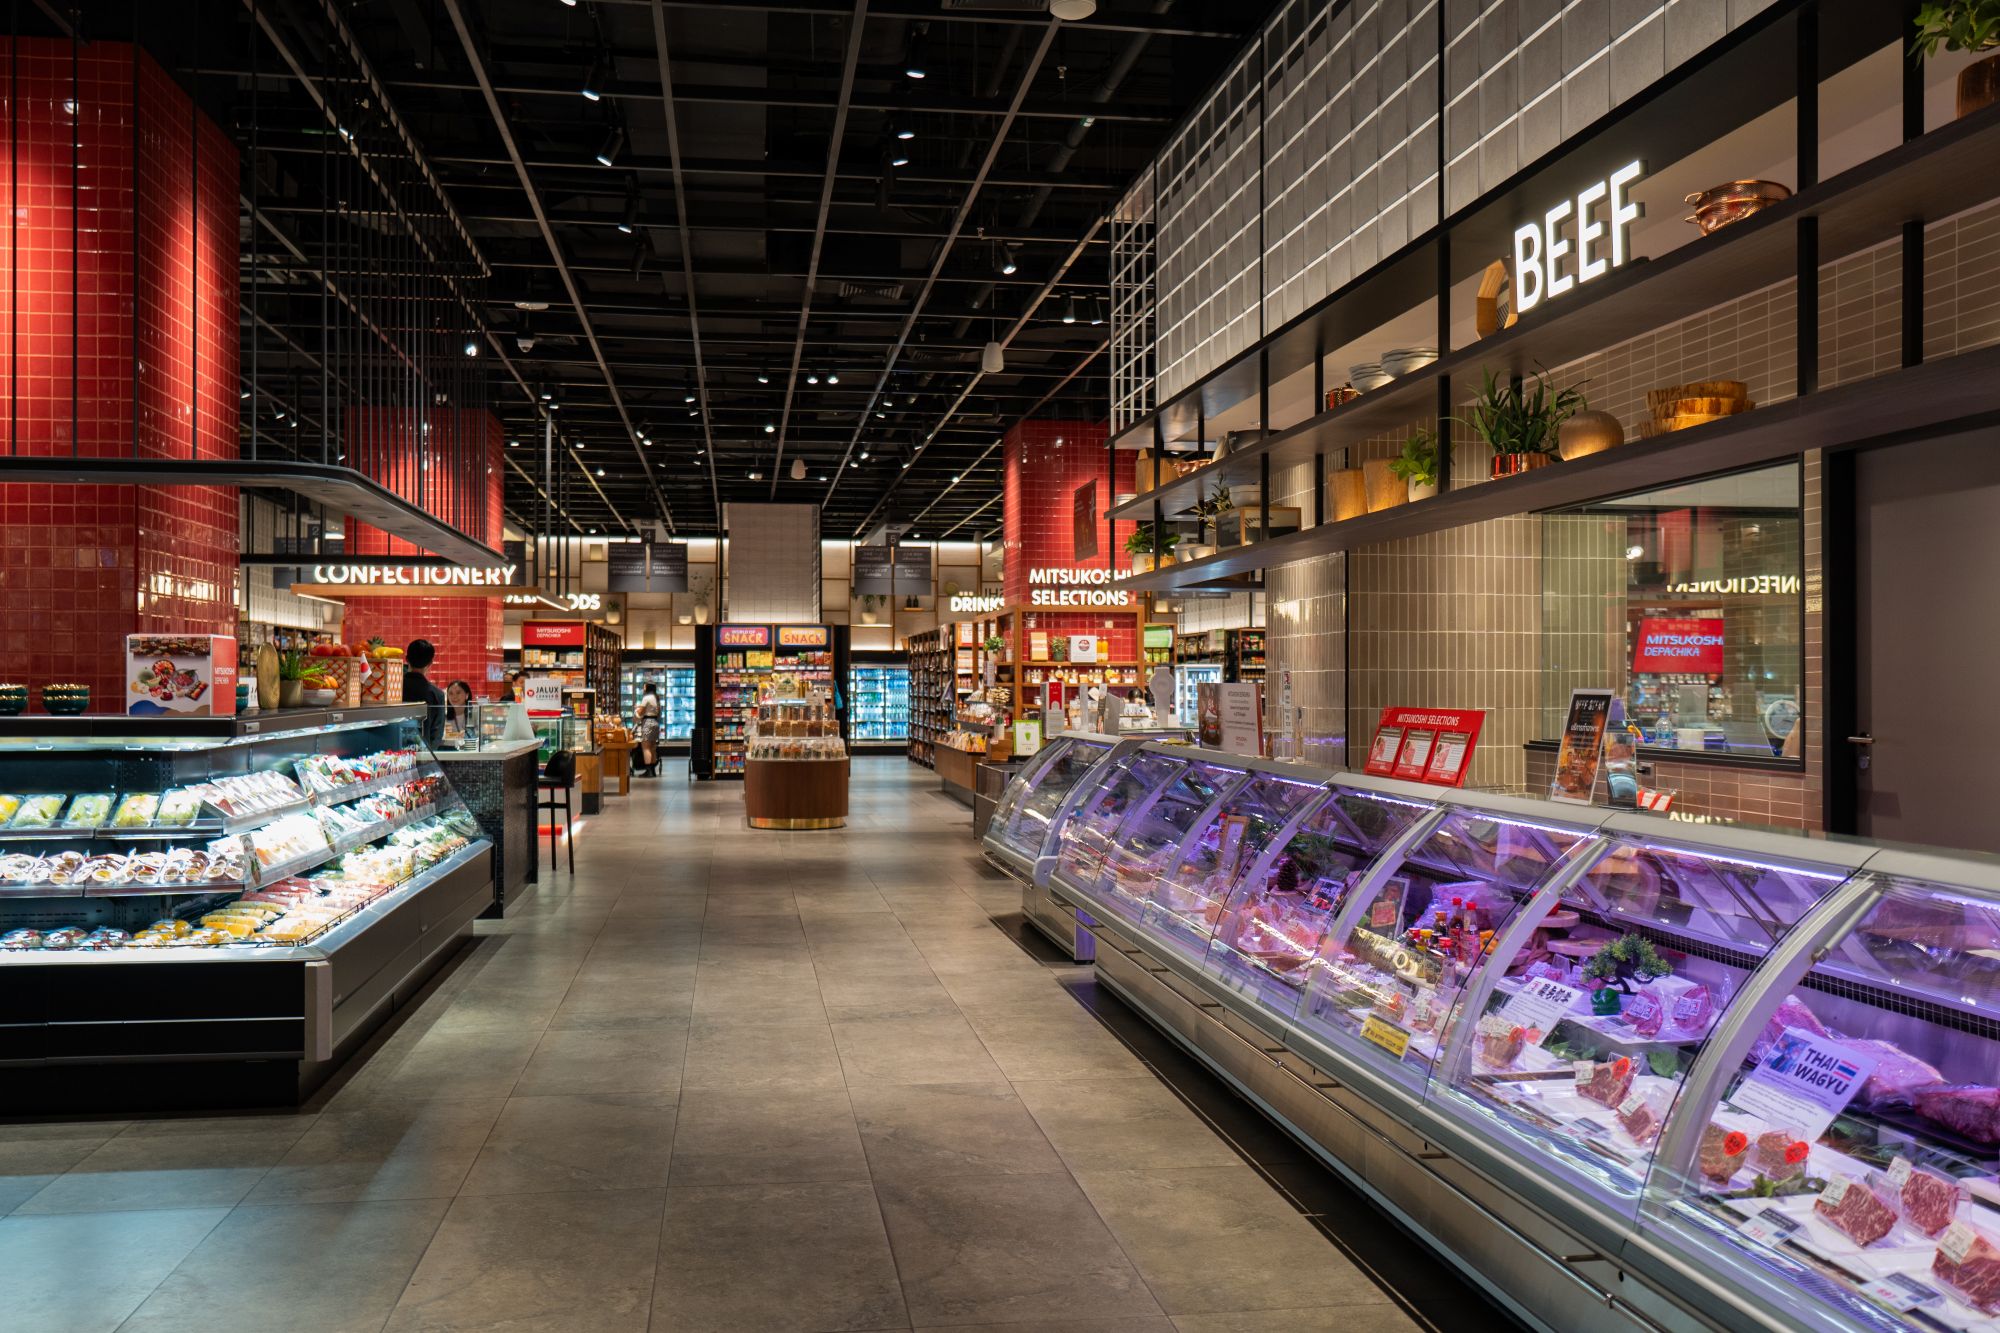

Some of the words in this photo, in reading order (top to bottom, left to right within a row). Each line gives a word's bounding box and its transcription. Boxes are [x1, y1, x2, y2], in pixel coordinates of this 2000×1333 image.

[1514, 160, 1640, 313] BEEF
[644, 531, 651, 540] 4
[314, 565, 516, 585] CONFECTIONERY
[1031, 590, 1128, 606] SELECTIONS
[724, 633, 763, 643] SNACK
[784, 634, 822, 644] SNACK
[1644, 647, 1700, 657] DEPACHIKA
[536, 686, 559, 694] JALUX
[1397, 713, 1428, 723] MITSUKOSHI
[1427, 715, 1460, 727] SELECTIONS
[1804, 1047, 1840, 1072] THAI
[1794, 1063, 1850, 1096] WAGYU
